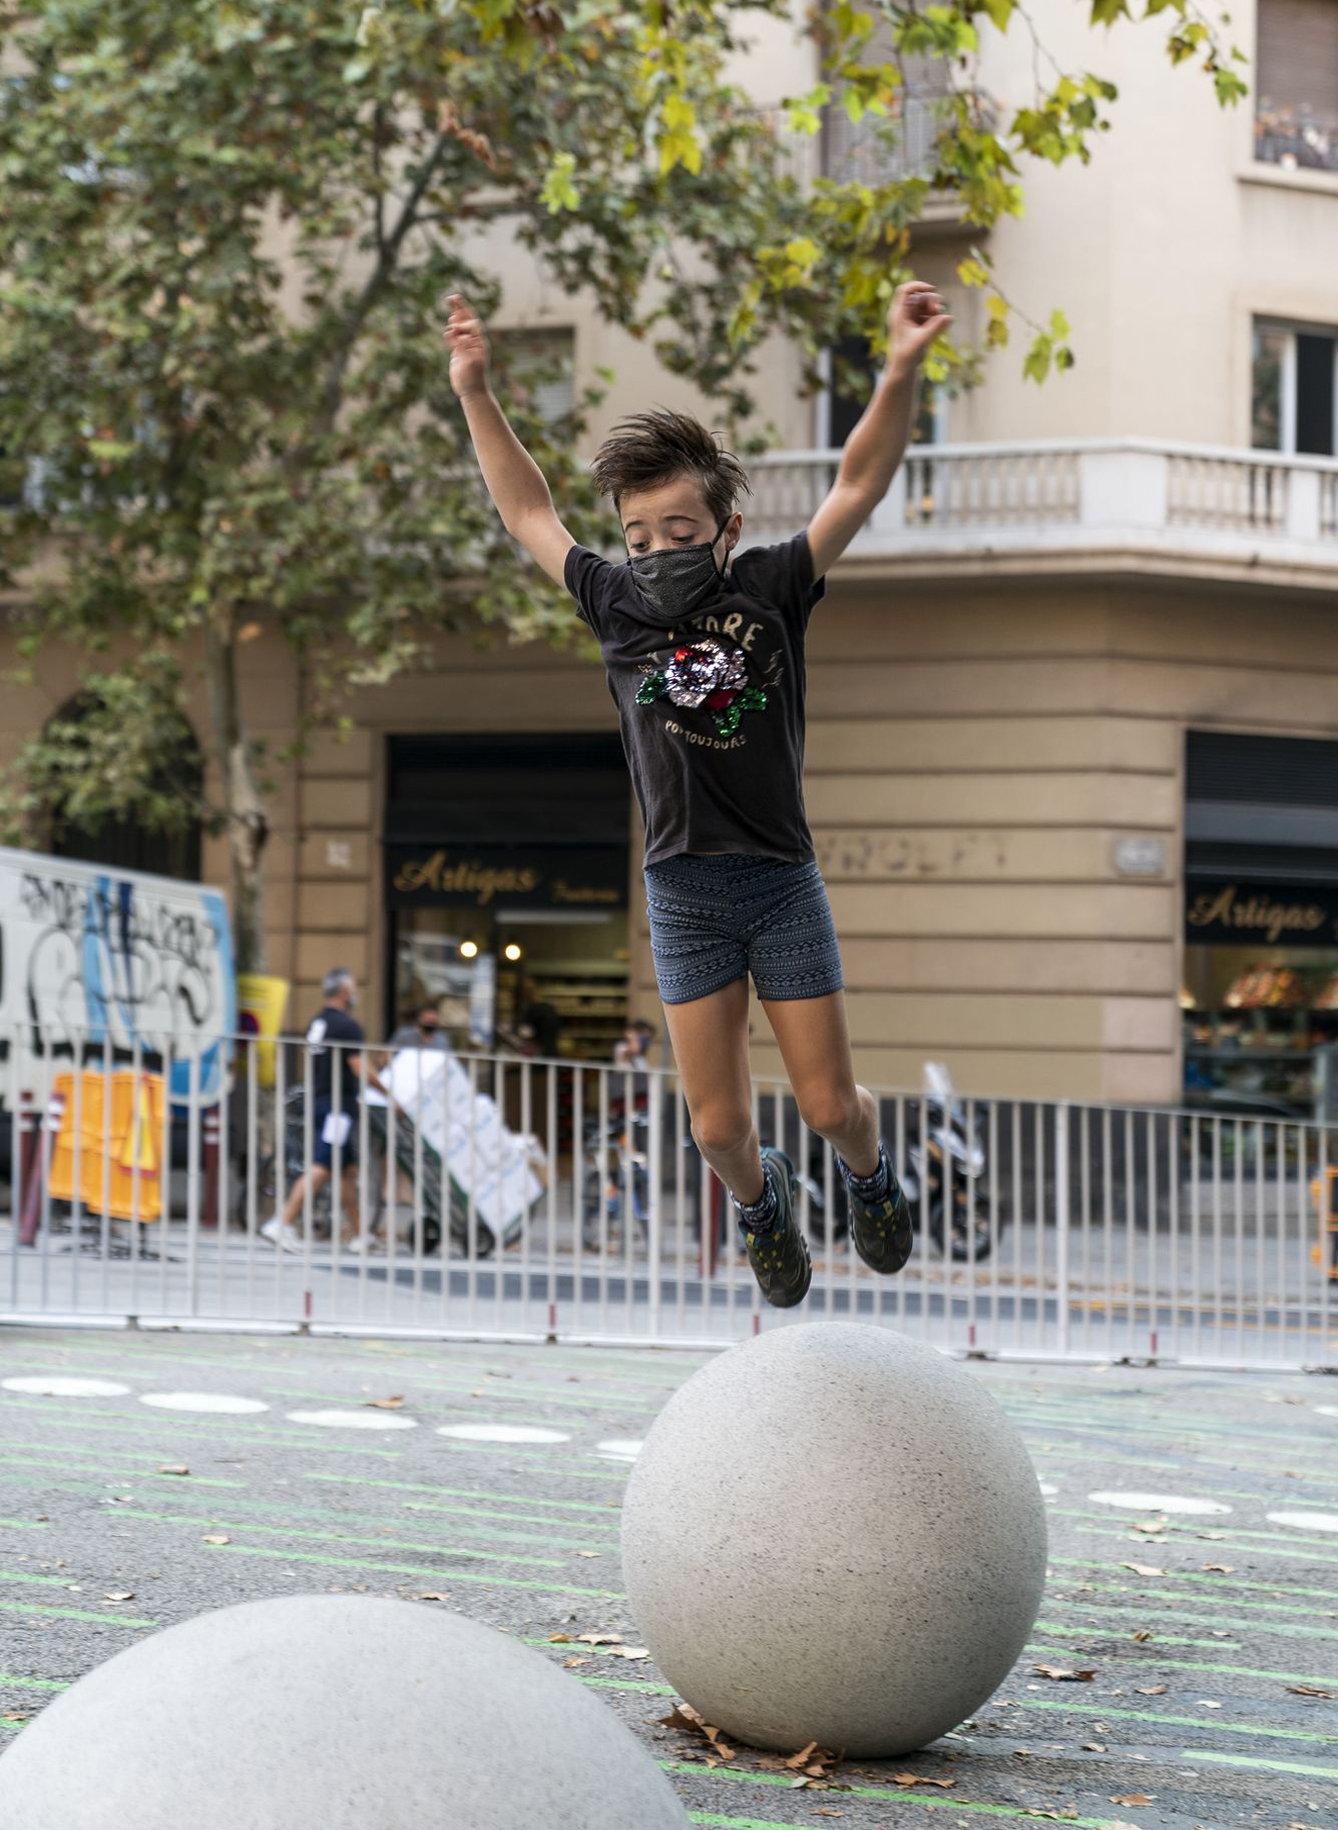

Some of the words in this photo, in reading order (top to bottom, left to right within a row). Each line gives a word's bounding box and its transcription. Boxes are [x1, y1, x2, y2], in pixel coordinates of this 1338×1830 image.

[685, 731, 747, 750] TOUJOURS
[392, 850, 537, 906] Artigas
[1186, 883, 1326, 942] Artigas
